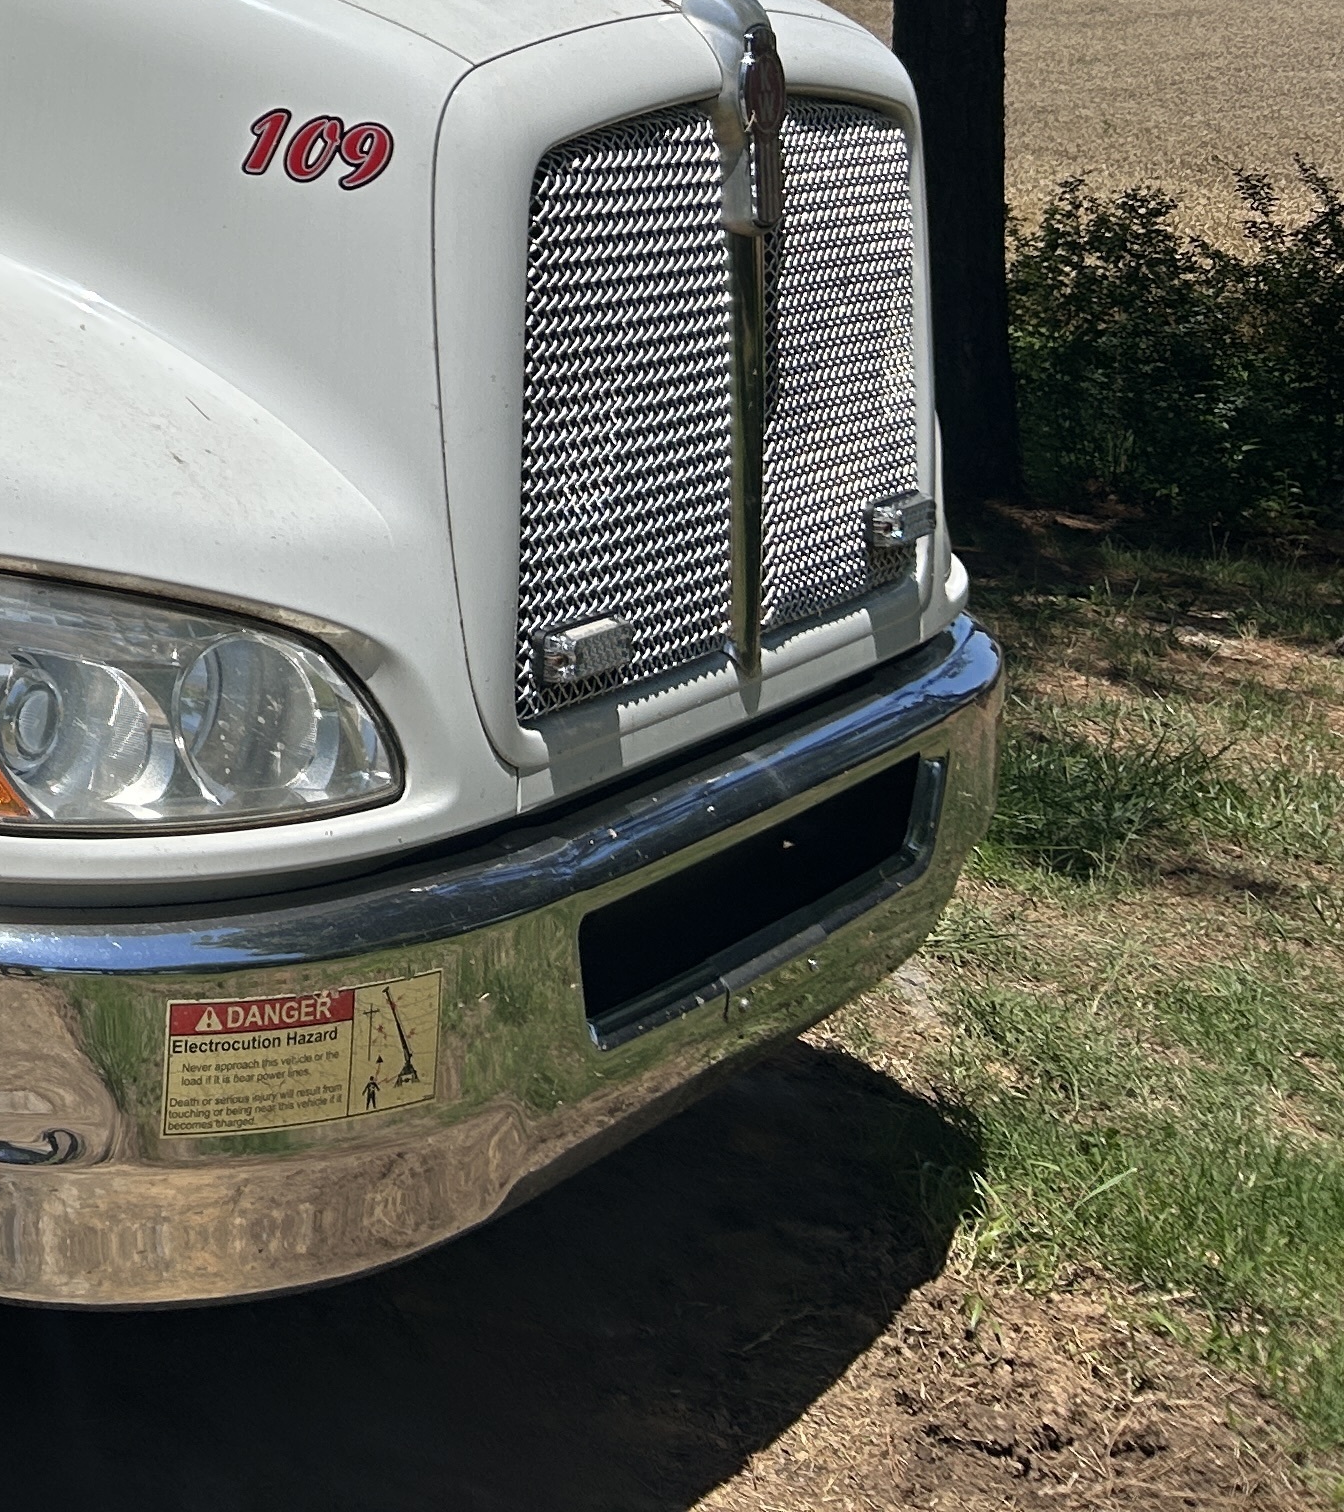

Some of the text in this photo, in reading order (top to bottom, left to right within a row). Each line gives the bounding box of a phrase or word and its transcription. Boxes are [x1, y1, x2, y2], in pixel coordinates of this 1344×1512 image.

[241, 107, 394, 191] 109
[226, 998, 332, 1029] DANGER
[172, 1026, 339, 1054] Electrocution Hazard
[182, 1063, 212, 1073] Never
[215, 1059, 260, 1073] approach
[262, 1058, 278, 1068] this
[314, 1053, 323, 1061] or
[326, 1050, 339, 1060] the
[181, 1075, 202, 1086] load
[256, 1071, 286, 1083] power
[169, 1097, 200, 1107] Death
[202, 1098, 213, 1106] or
[215, 1095, 250, 1105] serious
[168, 1108, 211, 1120] touching
[213, 1108, 223, 1117] or
[225, 1106, 252, 1117] being
[168, 1121, 213, 1130] becomes
